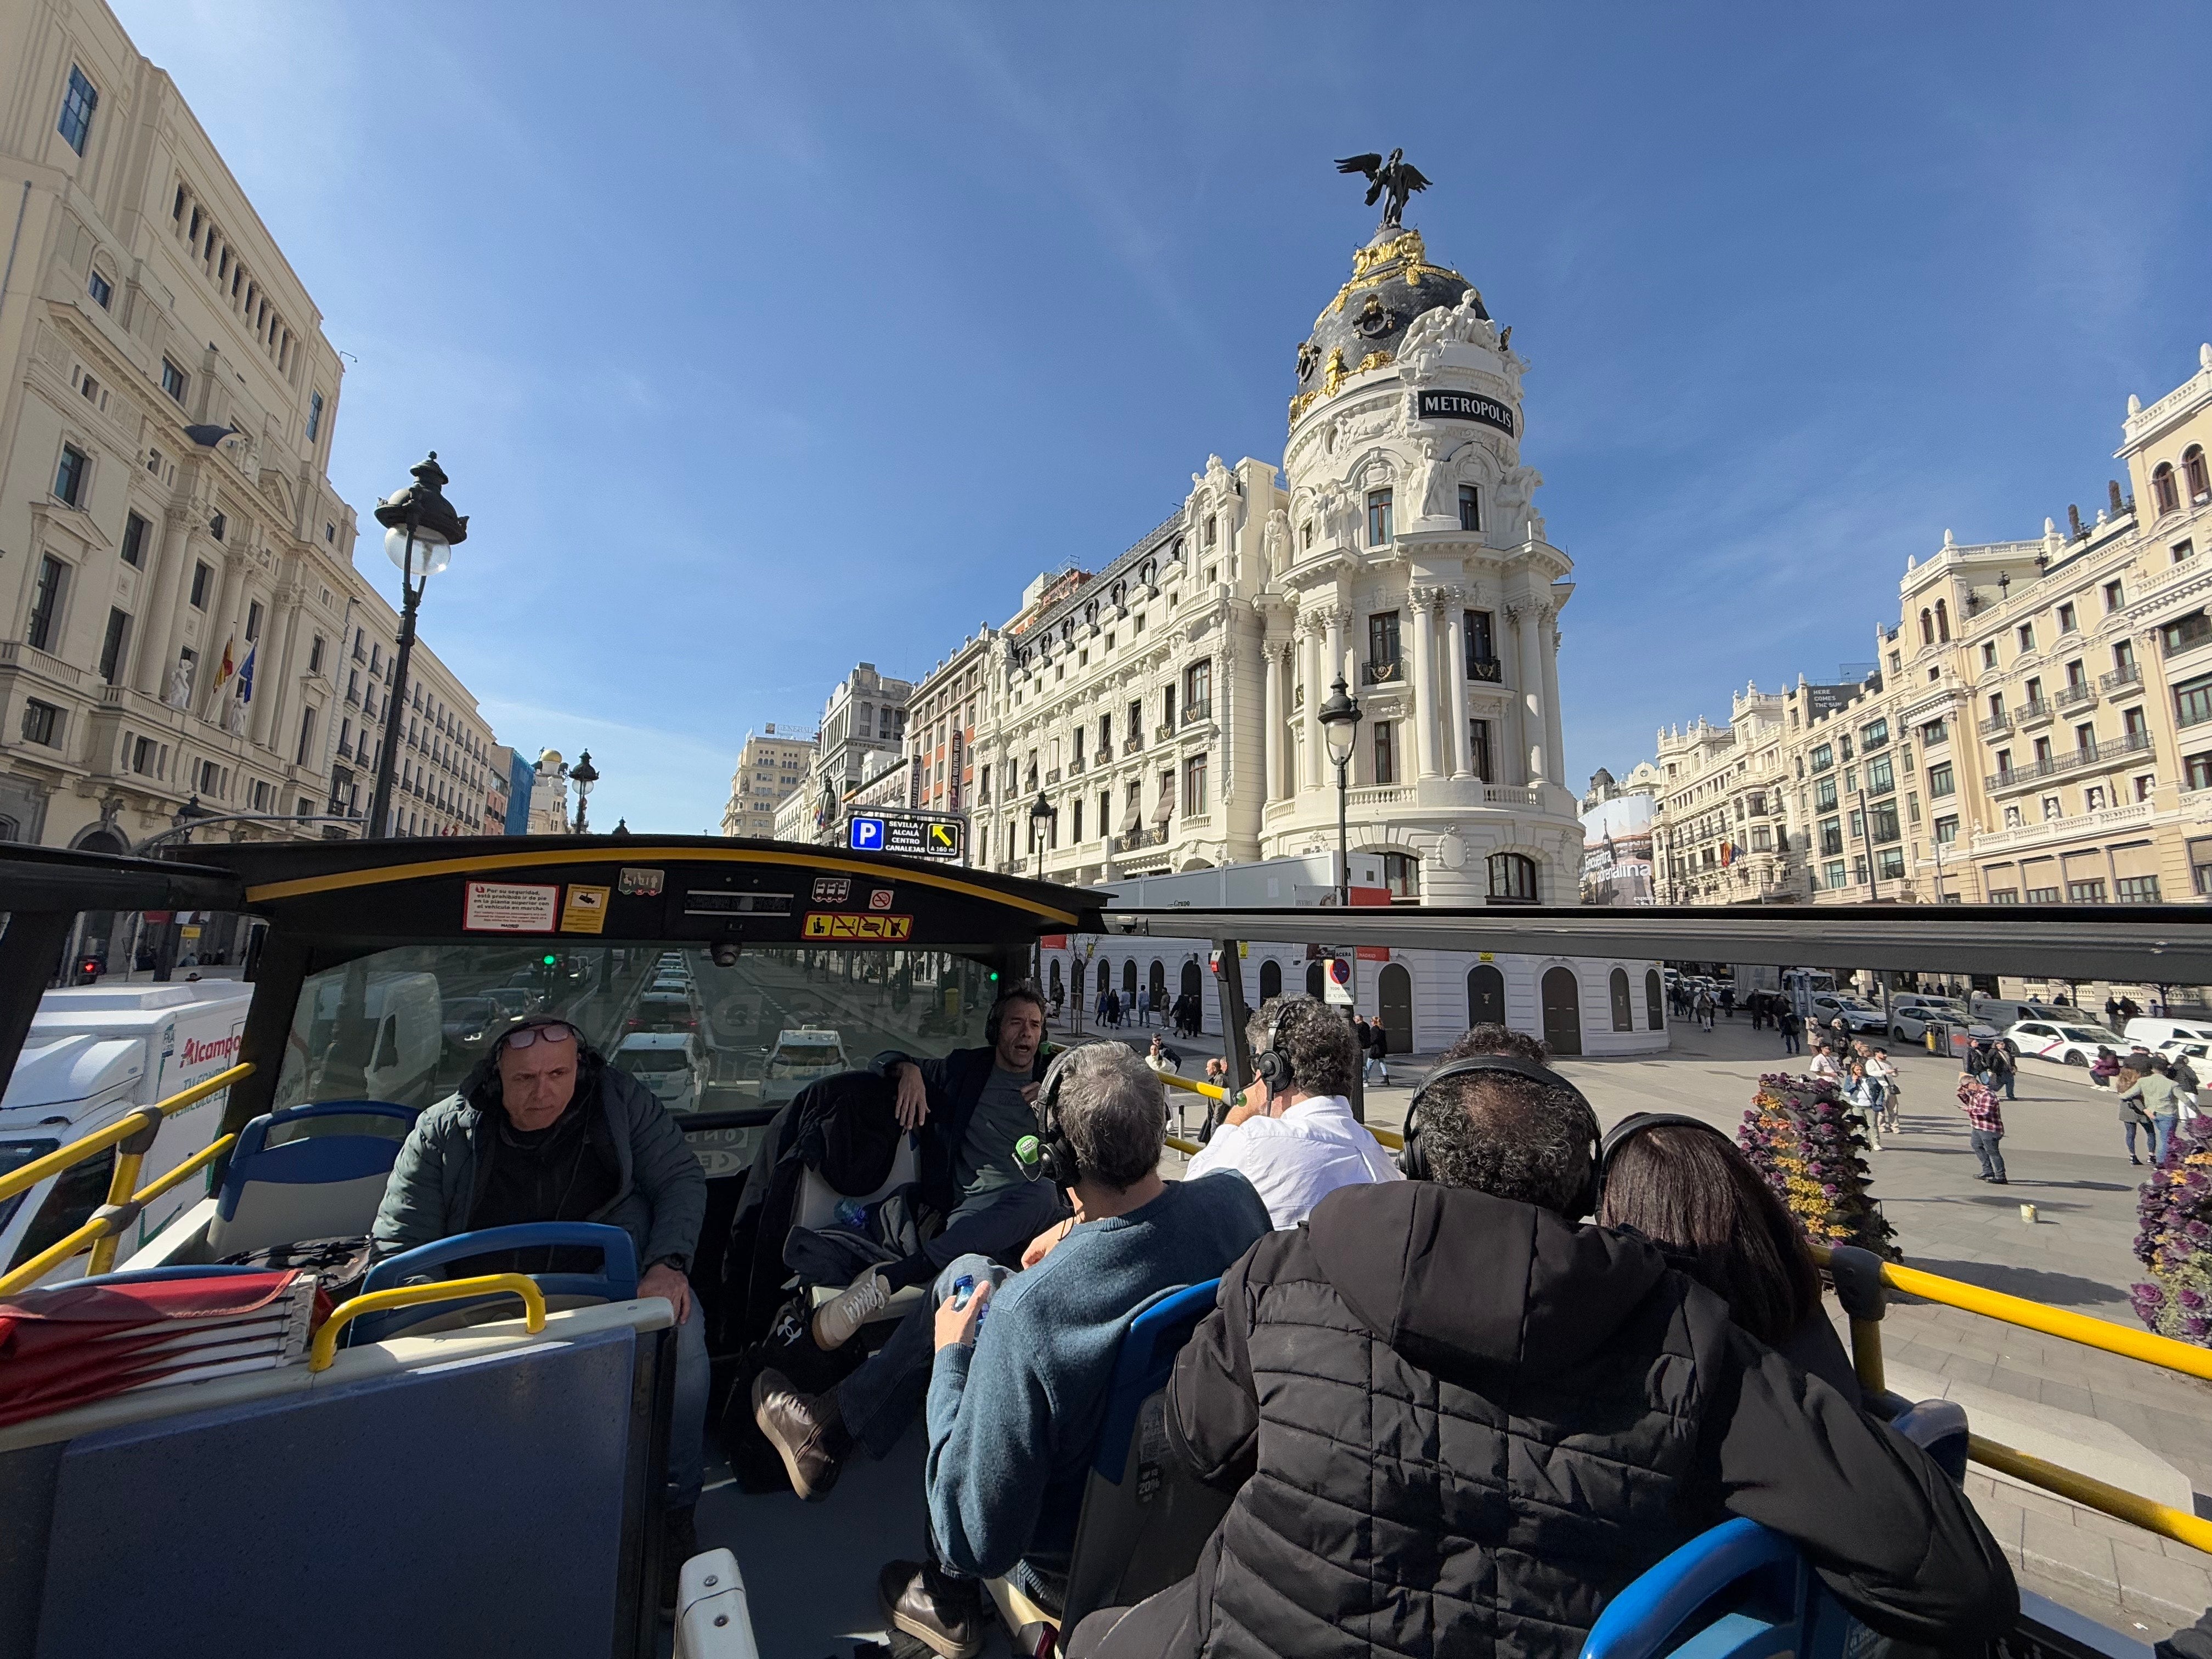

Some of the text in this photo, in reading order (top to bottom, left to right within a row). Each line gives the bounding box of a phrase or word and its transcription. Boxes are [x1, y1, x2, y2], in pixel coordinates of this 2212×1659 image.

[1425, 396, 1512, 428] METROPOLIS
[777, 724, 813, 733] GENERALI
[860, 822, 877, 845] P
[888, 821, 918, 829] SEVILLA
[893, 829, 919, 837] ALCALÁ
[885, 844, 926, 854] CANALEJAS
[1584, 850, 1611, 871] Encuentra
[1597, 862, 1652, 884] adrenalina
[179, 1035, 242, 1069] Alcampo
